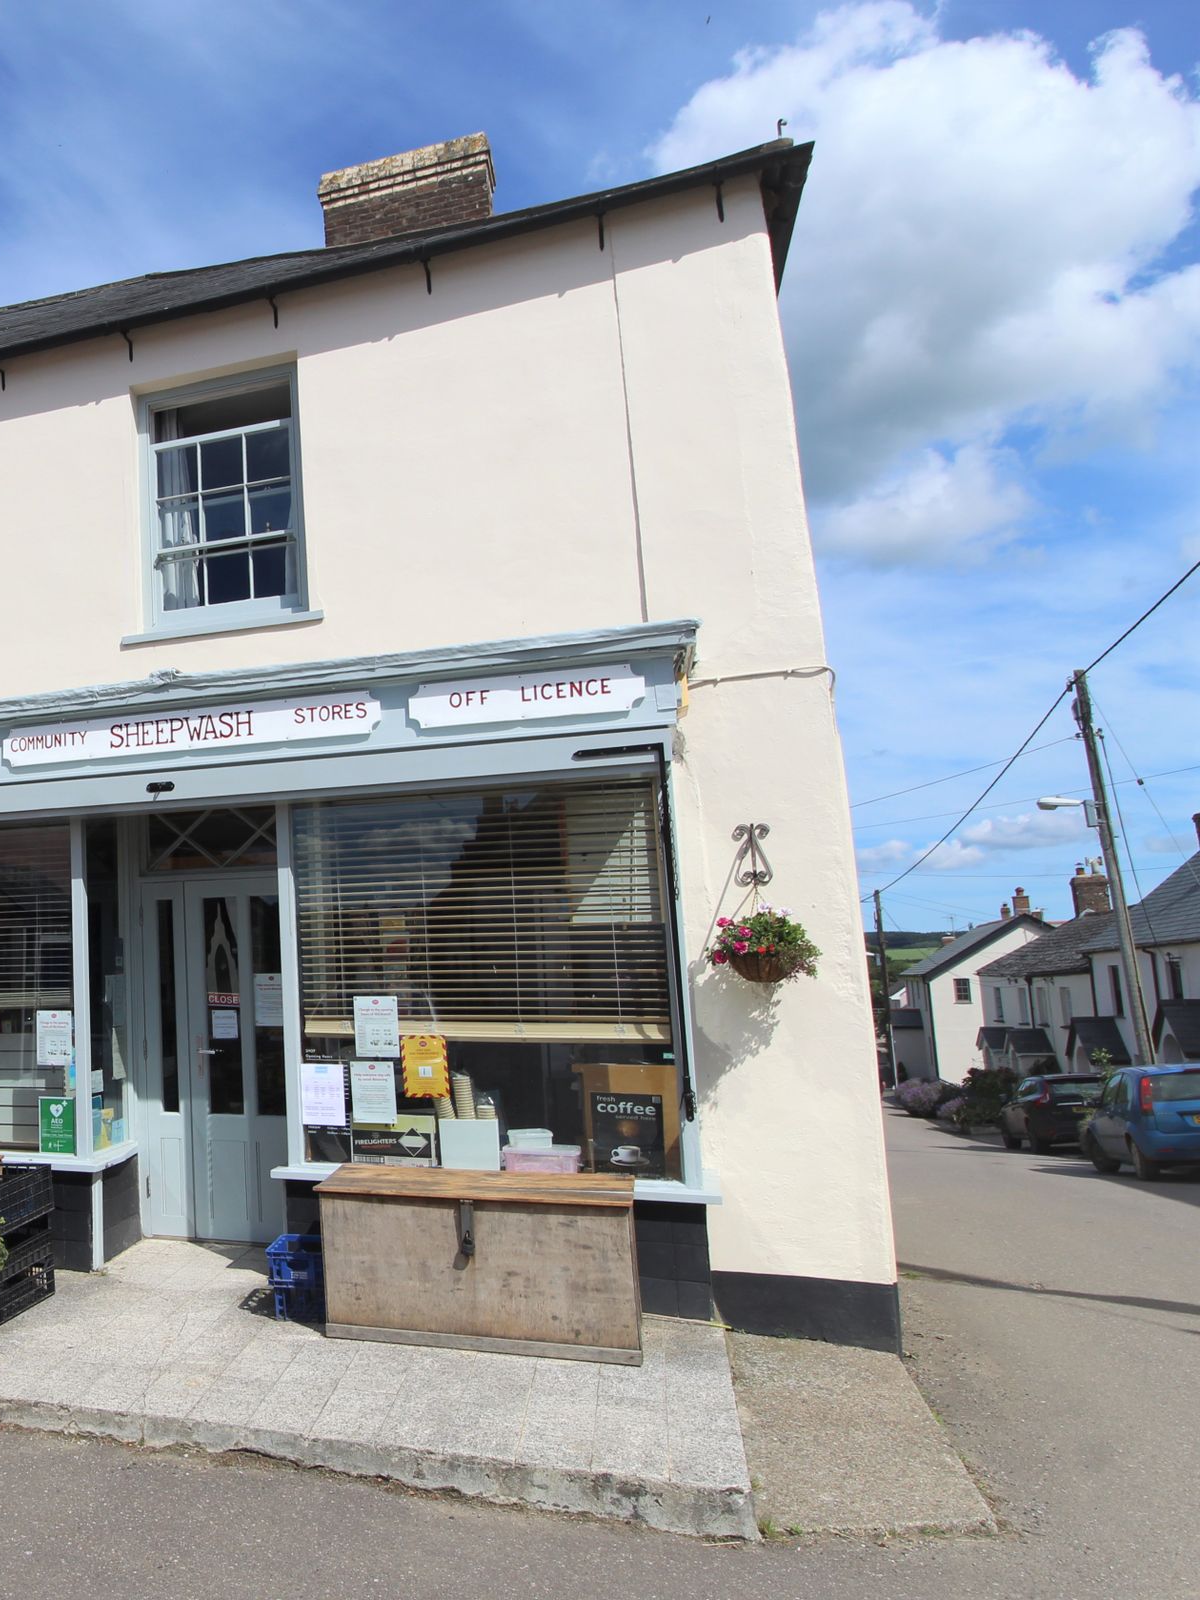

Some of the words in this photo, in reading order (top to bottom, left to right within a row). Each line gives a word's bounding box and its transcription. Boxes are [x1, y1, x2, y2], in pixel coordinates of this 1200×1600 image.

[449, 689, 491, 709] OFF
[520, 677, 612, 702] LICENCE
[10, 730, 88, 754] COMMUNITY
[109, 710, 255, 749] SHEEPWASH
[294, 701, 368, 724] STORES
[208, 995, 240, 1004] CLOSE
[596, 1101, 656, 1115] coffee
